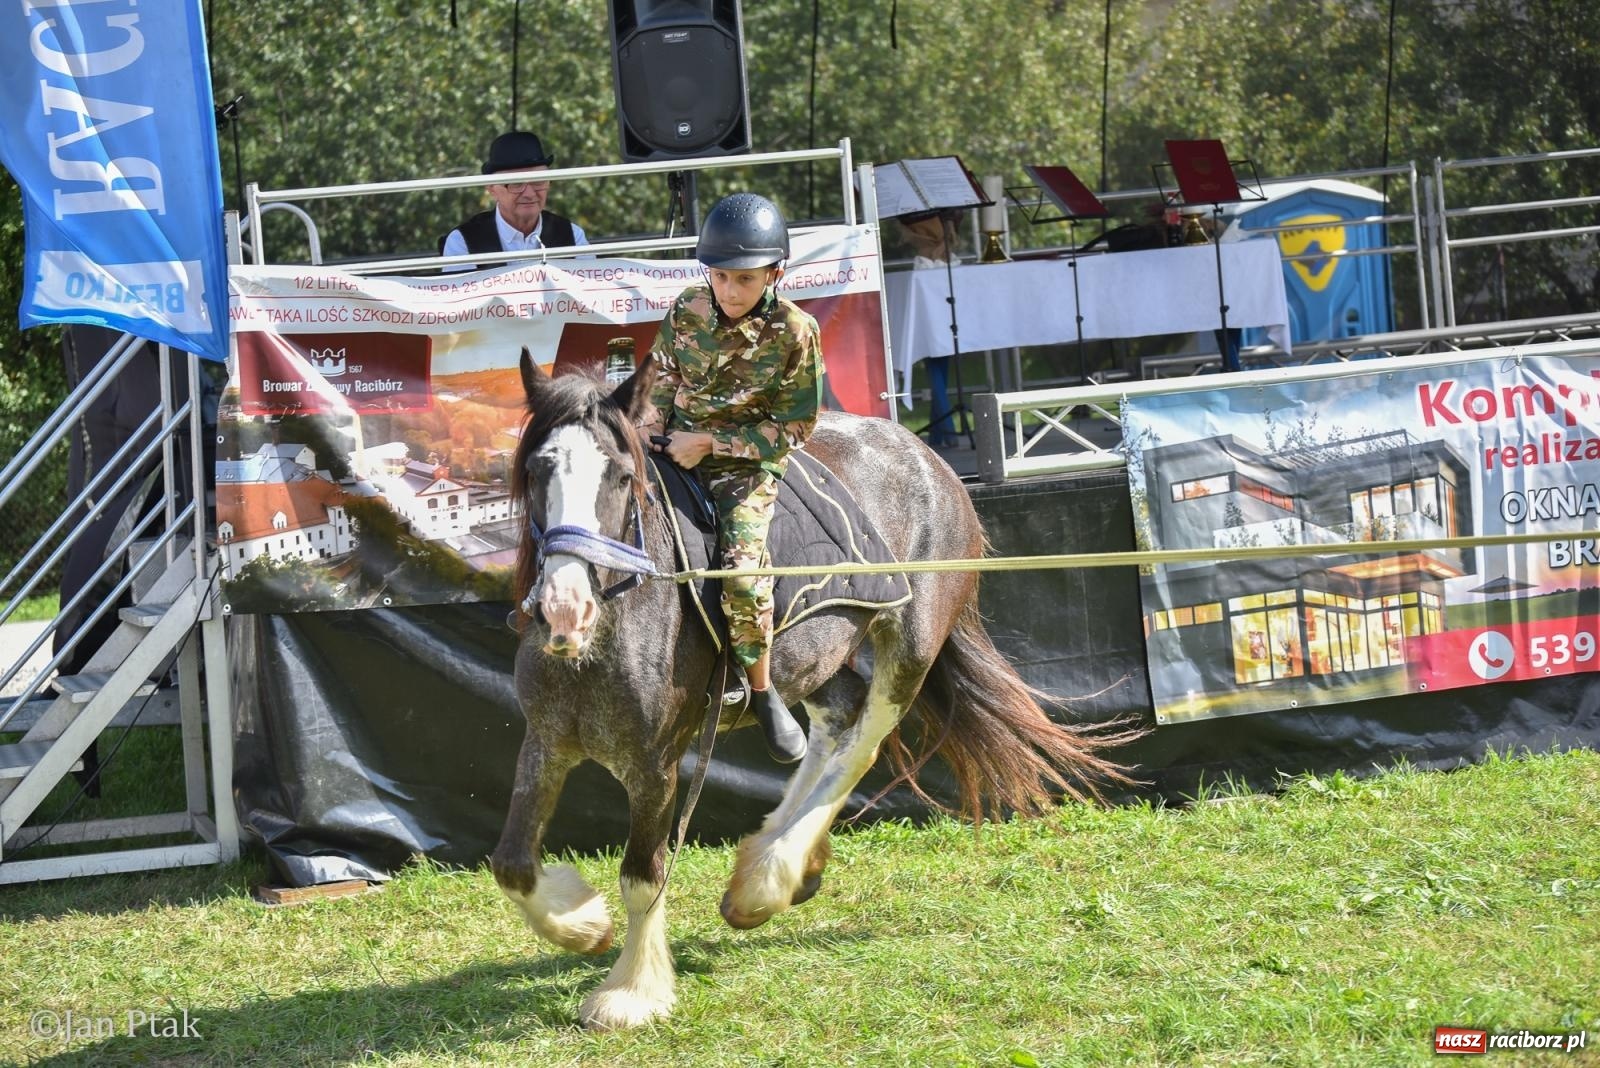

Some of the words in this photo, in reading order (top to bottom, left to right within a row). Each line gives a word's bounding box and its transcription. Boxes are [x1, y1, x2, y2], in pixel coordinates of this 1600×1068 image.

[294, 276, 313, 290] 1/2
[463, 280, 479, 294] 25
[267, 307, 303, 323] TAKA
[306, 305, 348, 323] ILOŚĆ
[352, 308, 414, 325] SZKODZI
[418, 307, 484, 325] ZDROWIU
[486, 302, 537, 319] KOBIET
[540, 302, 553, 315] W
[610, 297, 641, 313] JEST
[262, 378, 303, 393] Browar
[354, 377, 403, 393] Racibórz
[1485, 432, 1600, 470] realiza
[1499, 483, 1600, 525] OKNA
[1530, 631, 1596, 668] 539
